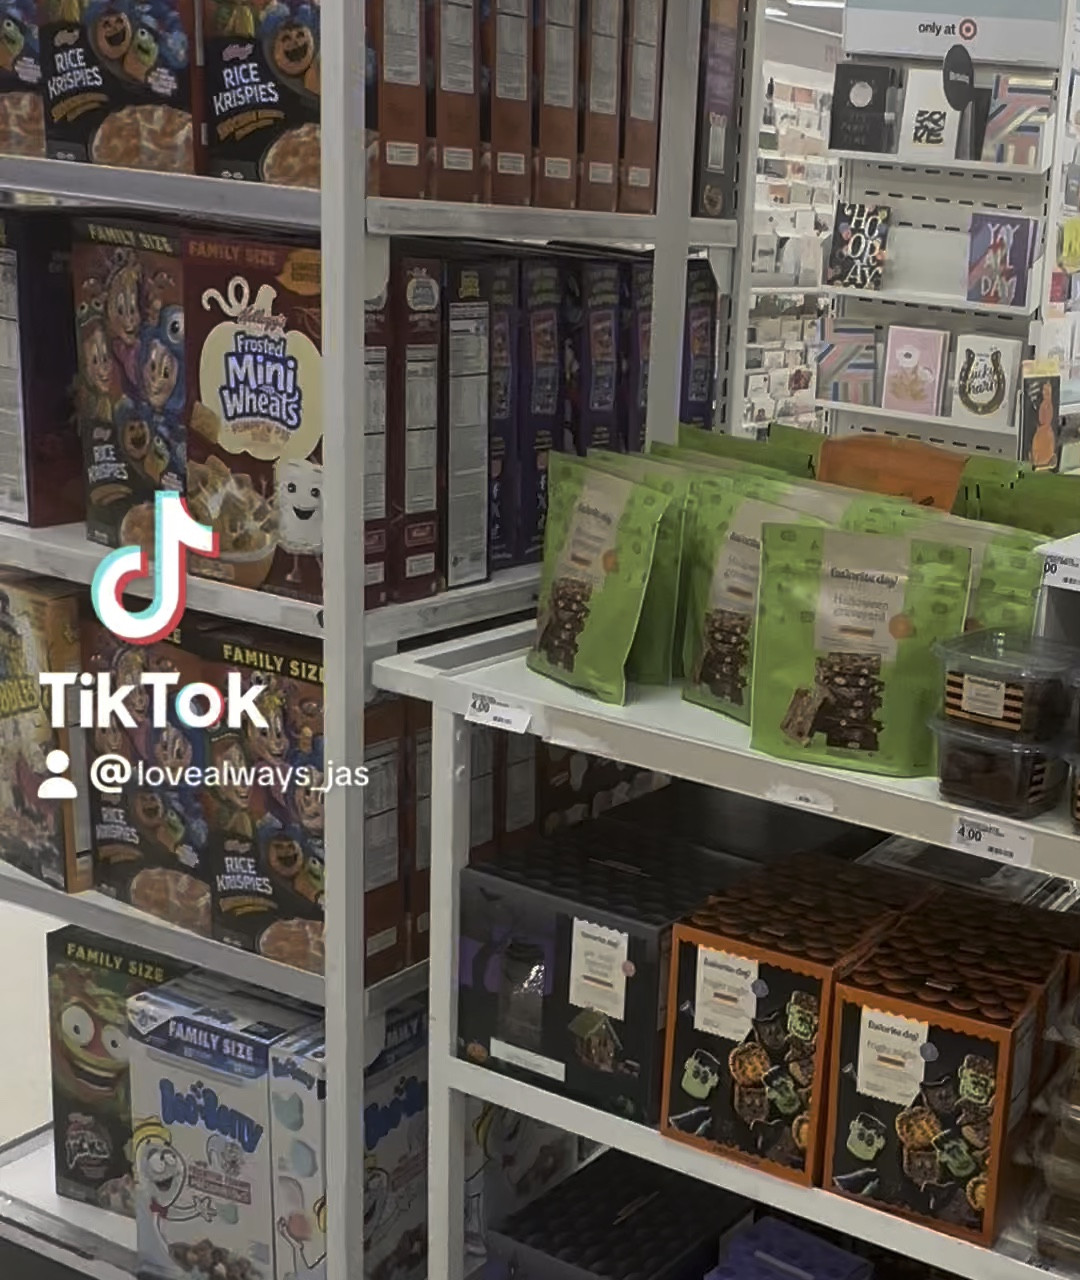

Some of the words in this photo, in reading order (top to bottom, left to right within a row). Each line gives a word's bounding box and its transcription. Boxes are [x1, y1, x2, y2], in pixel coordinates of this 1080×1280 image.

[918, 22, 942, 37] only
[944, 23, 956, 35] at
[54, 48, 86, 72] RICE
[47, 66, 103, 99] KRISPIES
[222, 63, 260, 88] RICE
[213, 81, 279, 116] KRISPIES
[88, 223, 136, 246] FAMILY
[140, 232, 174, 253] SIZE
[188, 241, 241, 265] FAMILY
[237, 334, 285, 357] Frosted
[227, 354, 295, 393] Mini
[222, 384, 300, 426] Wheats
[223, 644, 286, 672] FAMILY
[290, 659, 324, 682] SIZ
[224, 856, 257, 875] RICE
[216, 875, 273, 895] KRISPIES
[67, 942, 123, 970] FAMILY
[128, 960, 164, 982] SIZE
[168, 1020, 219, 1051] FAMILY
[222, 1038, 254, 1062] SIZE
